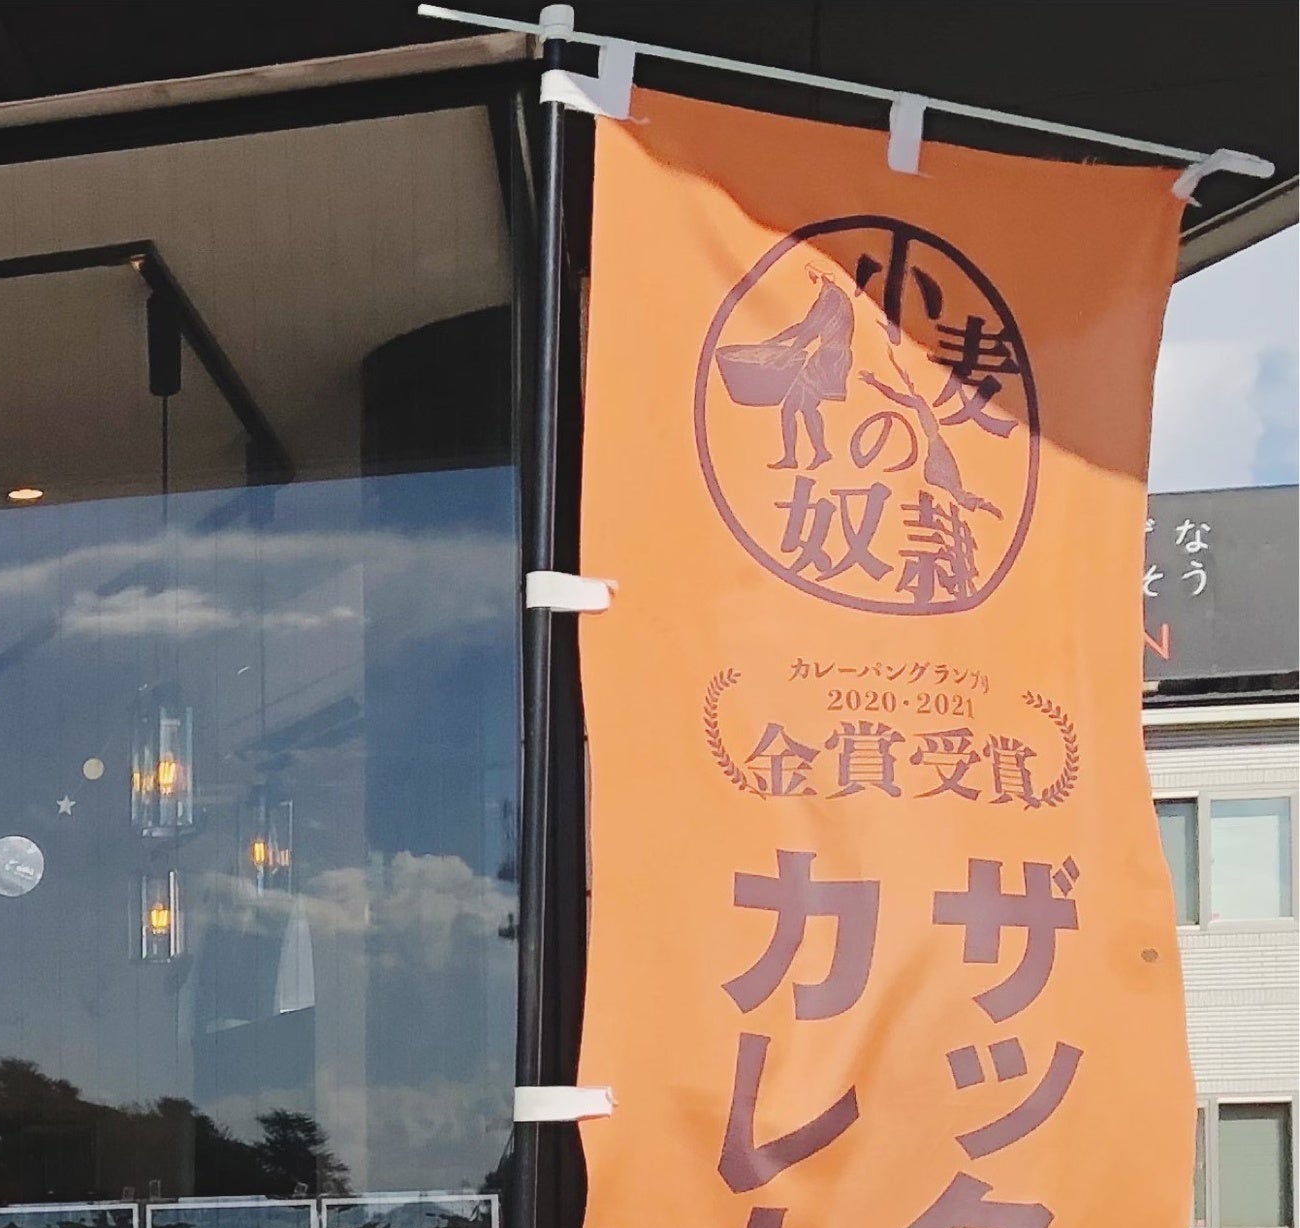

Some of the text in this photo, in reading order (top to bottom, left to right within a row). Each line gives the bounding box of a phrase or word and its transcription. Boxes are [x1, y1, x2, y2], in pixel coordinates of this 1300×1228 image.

[855, 233, 1020, 438] 小麦
[850, 411, 918, 472] の
[774, 475, 981, 601] 奴隷
[744, 720, 1041, 810] 金賞受賞
